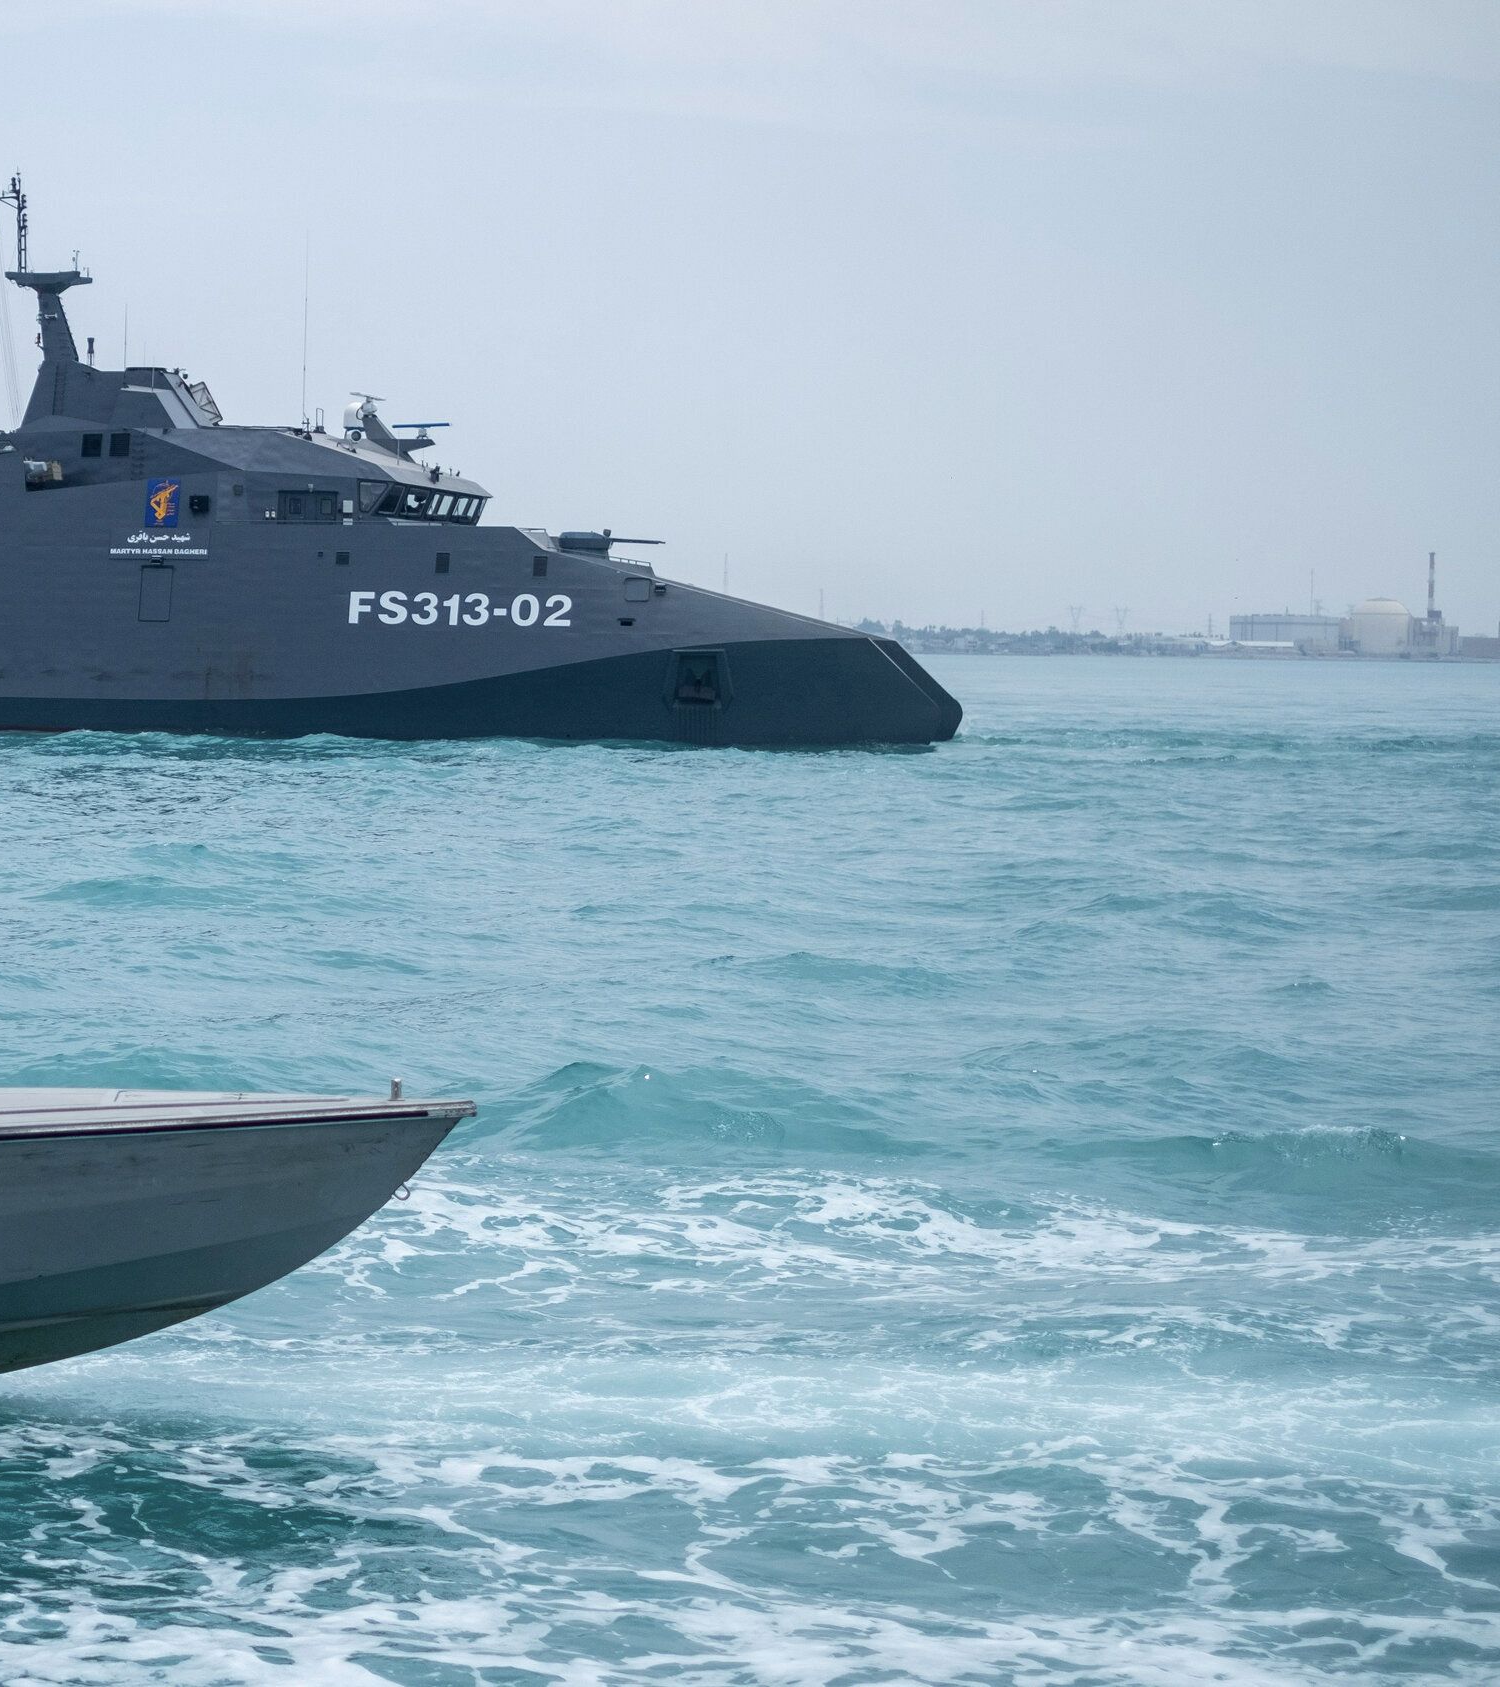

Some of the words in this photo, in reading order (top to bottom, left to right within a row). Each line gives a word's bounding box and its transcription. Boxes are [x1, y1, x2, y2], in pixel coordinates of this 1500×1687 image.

[127, 530, 149, 543] باقری
[149, 535, 170, 543] حسن
[171, 532, 191, 543] شهید
[348, 590, 573, 627] FS313-02
